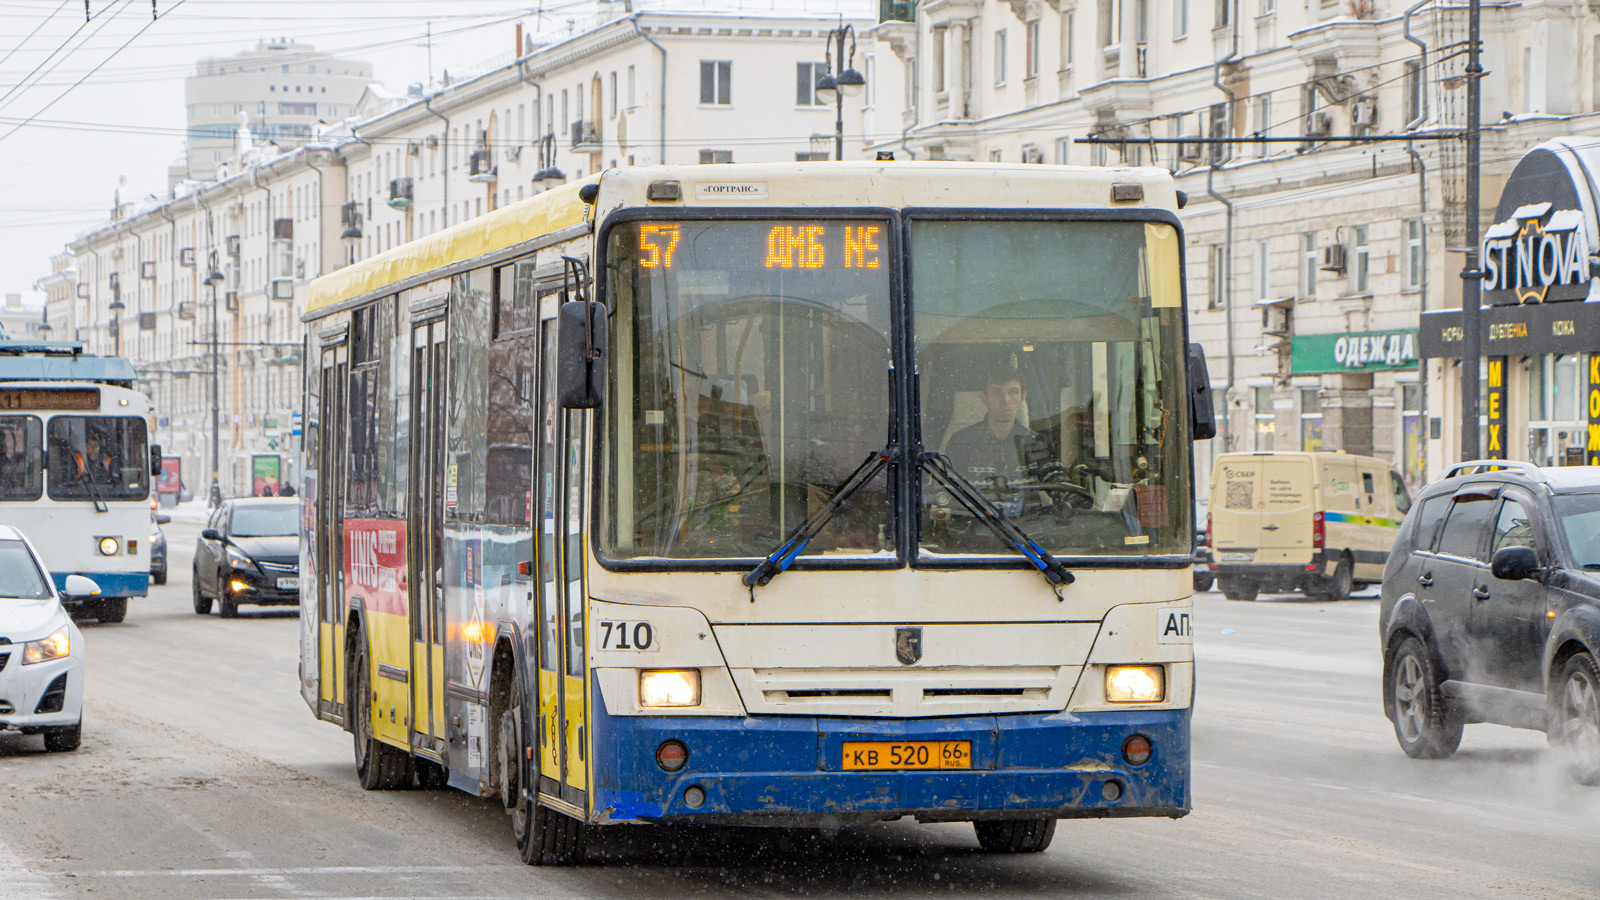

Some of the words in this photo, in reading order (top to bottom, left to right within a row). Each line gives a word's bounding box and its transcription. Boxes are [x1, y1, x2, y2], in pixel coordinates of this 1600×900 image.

[639, 226, 679, 268] 57
[766, 225, 824, 268] ДМБ
[1489, 321, 1528, 340] ДУБЛЕНКА
[1552, 319, 1576, 336] КОЖА
[1334, 333, 1414, 367] ОДЕЖДА
[600, 621, 653, 650] 710
[890, 745, 929, 766] 520
[942, 743, 962, 759] 66
